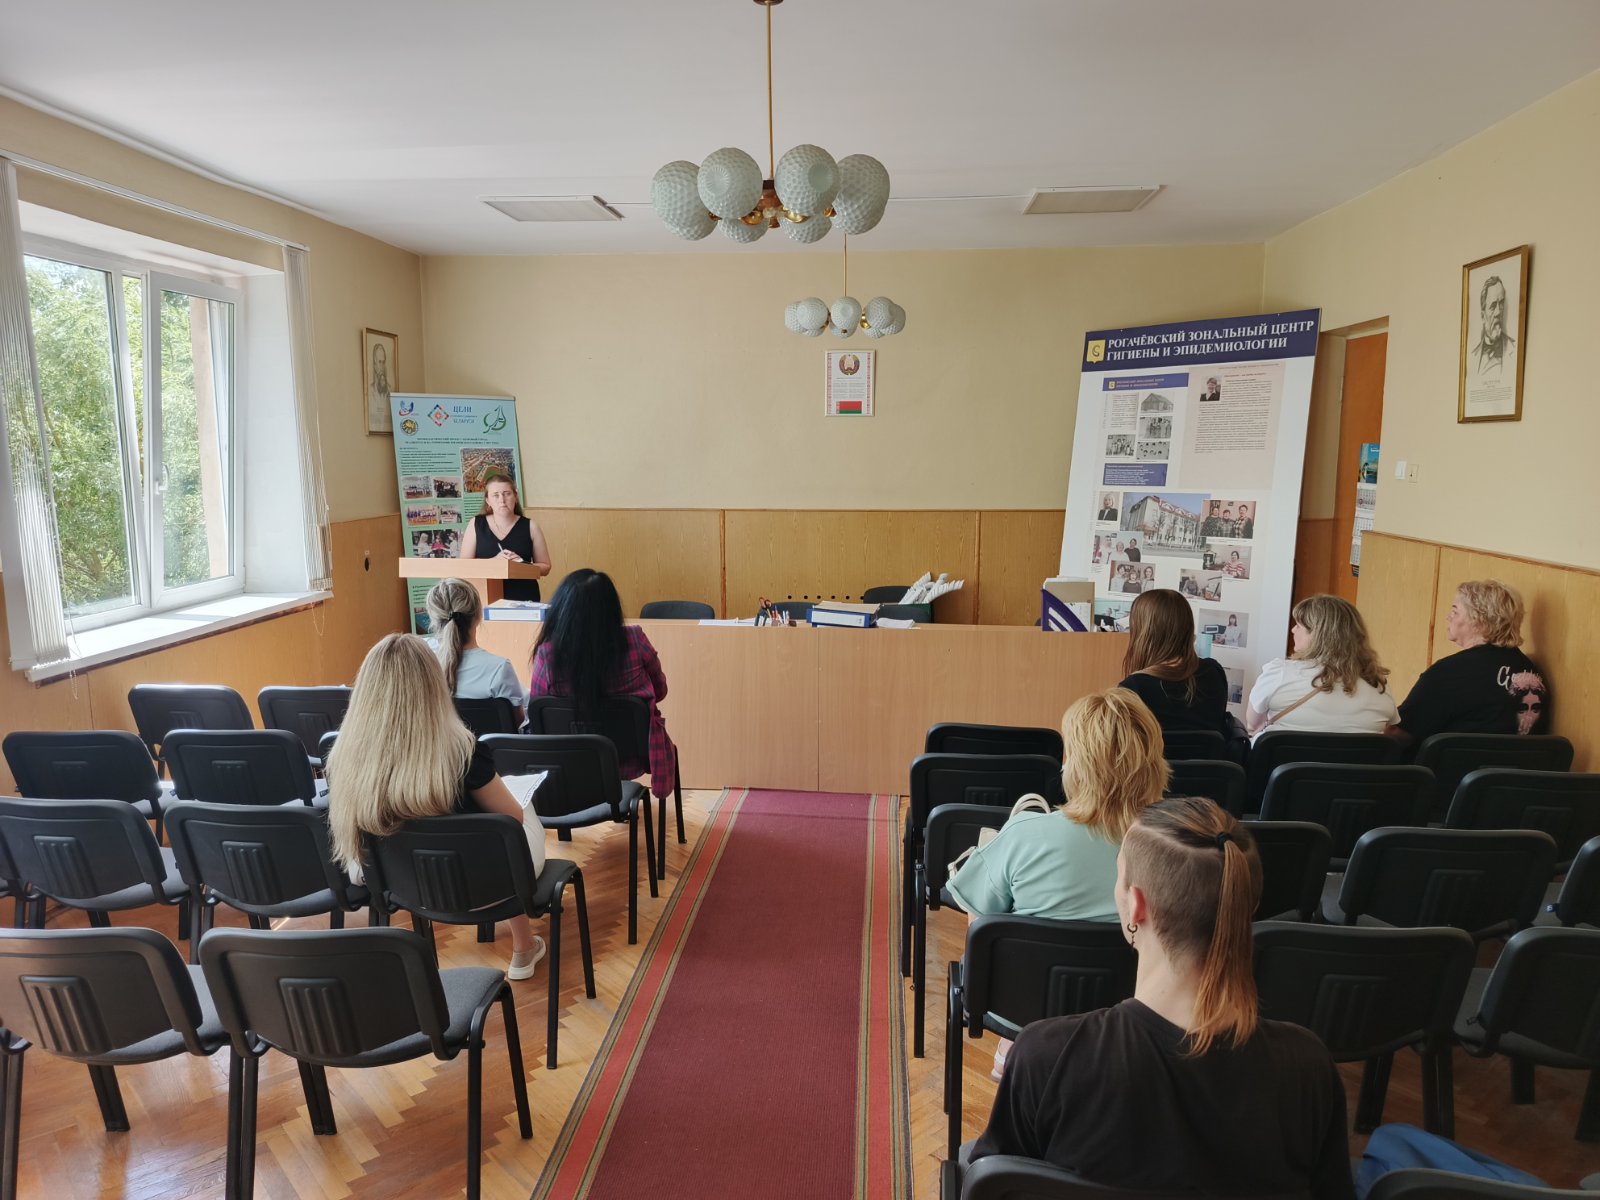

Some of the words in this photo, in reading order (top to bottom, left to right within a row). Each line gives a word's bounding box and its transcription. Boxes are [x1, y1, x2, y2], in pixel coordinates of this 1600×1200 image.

[1188, 323, 1267, 340] ЗОНАЛЬНЫЙ
[1271, 320, 1314, 335] ЦЕНТР
[1106, 347, 1160, 361] ГИГИЕНЫ
[1162, 346, 1171, 357] И
[1173, 337, 1288, 356] ЭПИДЕМИОЛОГИИ
[453, 405, 472, 414] ЦЕЛИ
